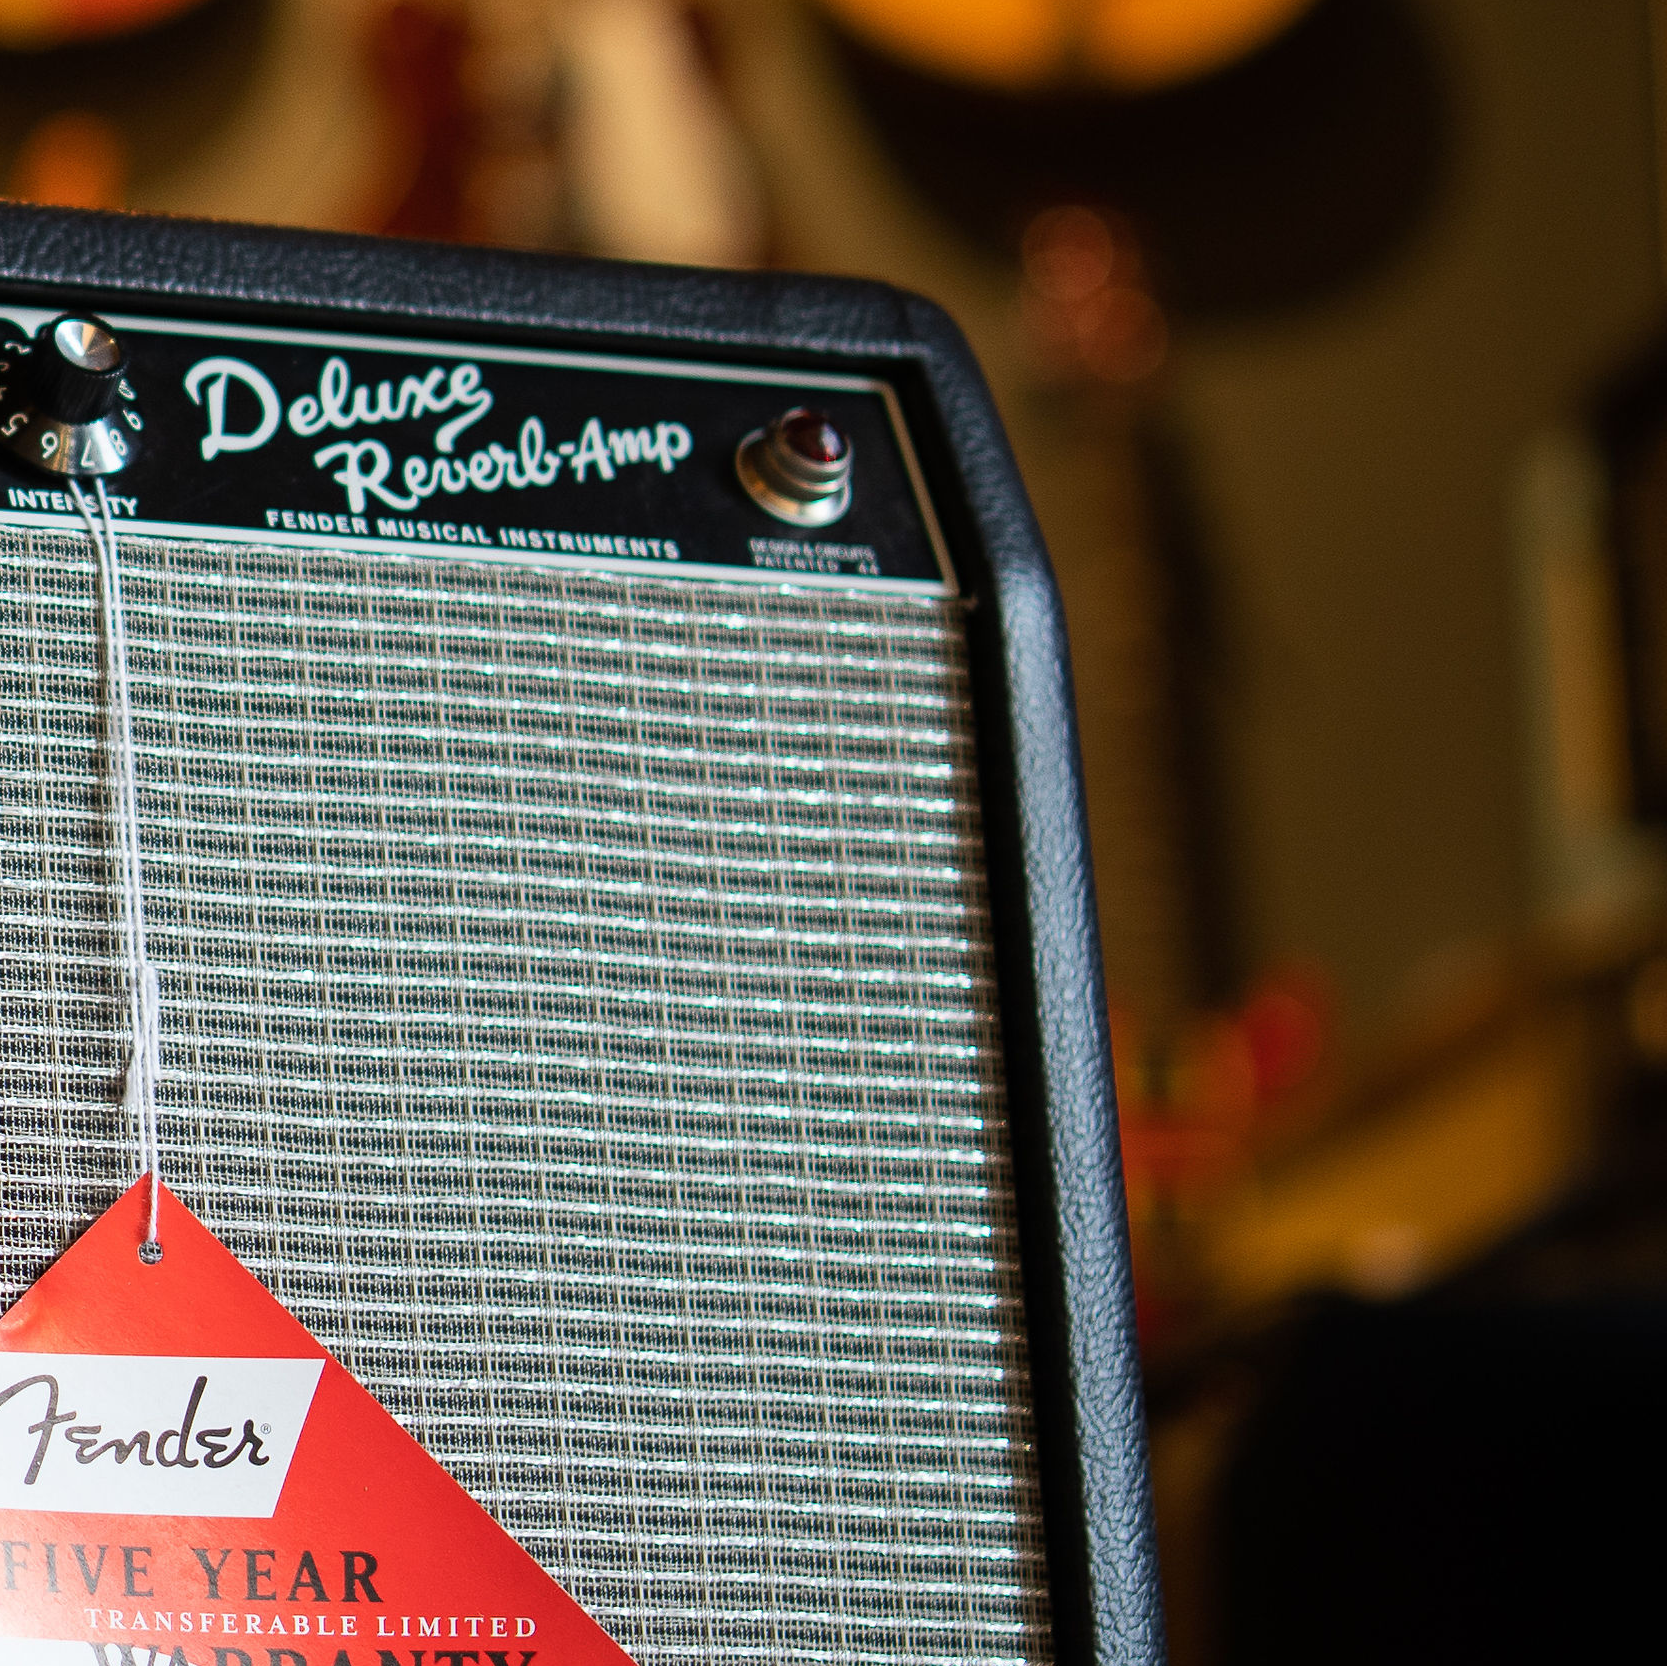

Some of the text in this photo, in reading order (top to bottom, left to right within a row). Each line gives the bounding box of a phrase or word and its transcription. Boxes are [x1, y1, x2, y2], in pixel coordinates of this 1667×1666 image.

[5, 341, 31, 355] 2
[184, 355, 493, 461] Deluxe
[1, 412, 29, 437] 5
[80, 439, 96, 467] 7
[109, 429, 129, 457] 8
[314, 416, 694, 514] Reverb-Amp
[8, 488, 138, 516] INTENSTY
[266, 509, 681, 560] FENDER MUSICAL INSTRUMENTS
[2, 1540, 384, 1603] FIVE YEAR
[84, 1608, 537, 1638] TRANSFERABLE LIMITED
